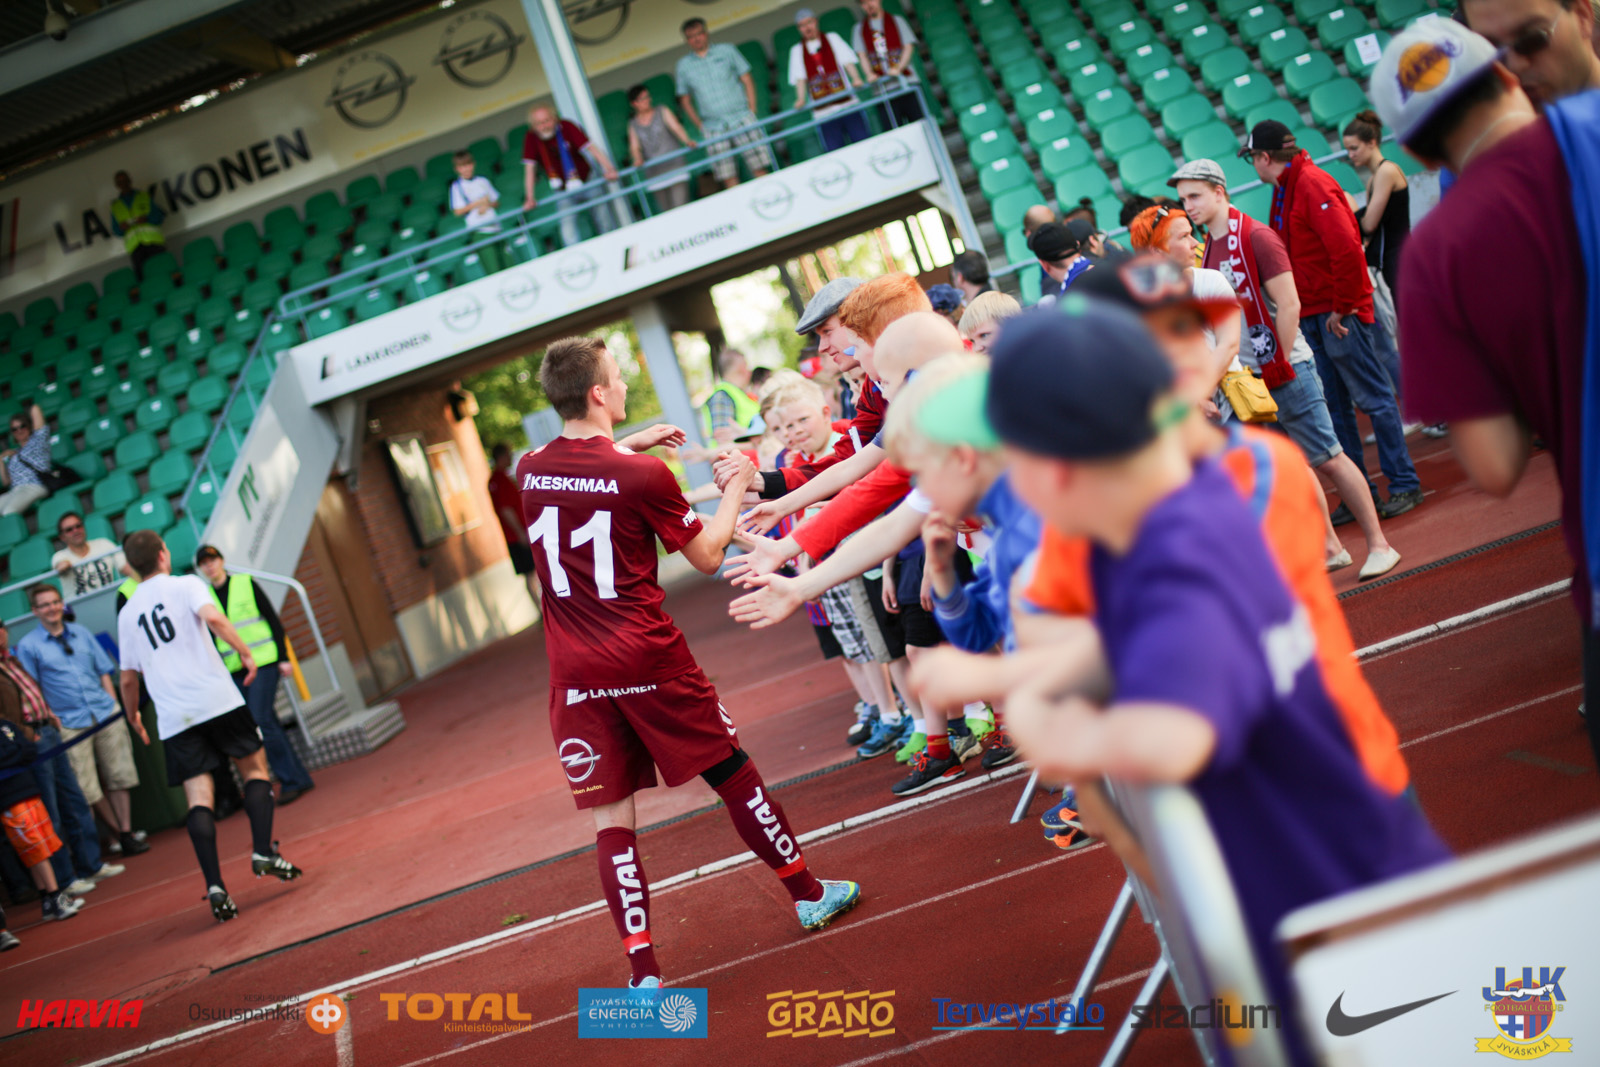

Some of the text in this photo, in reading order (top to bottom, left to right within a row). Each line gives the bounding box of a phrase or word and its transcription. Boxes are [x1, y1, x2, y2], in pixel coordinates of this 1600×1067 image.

[53, 127, 312, 254] LAKONEN
[530, 475, 619, 494] KESKIMAA
[527, 506, 618, 599] 11
[137, 603, 176, 650] 16
